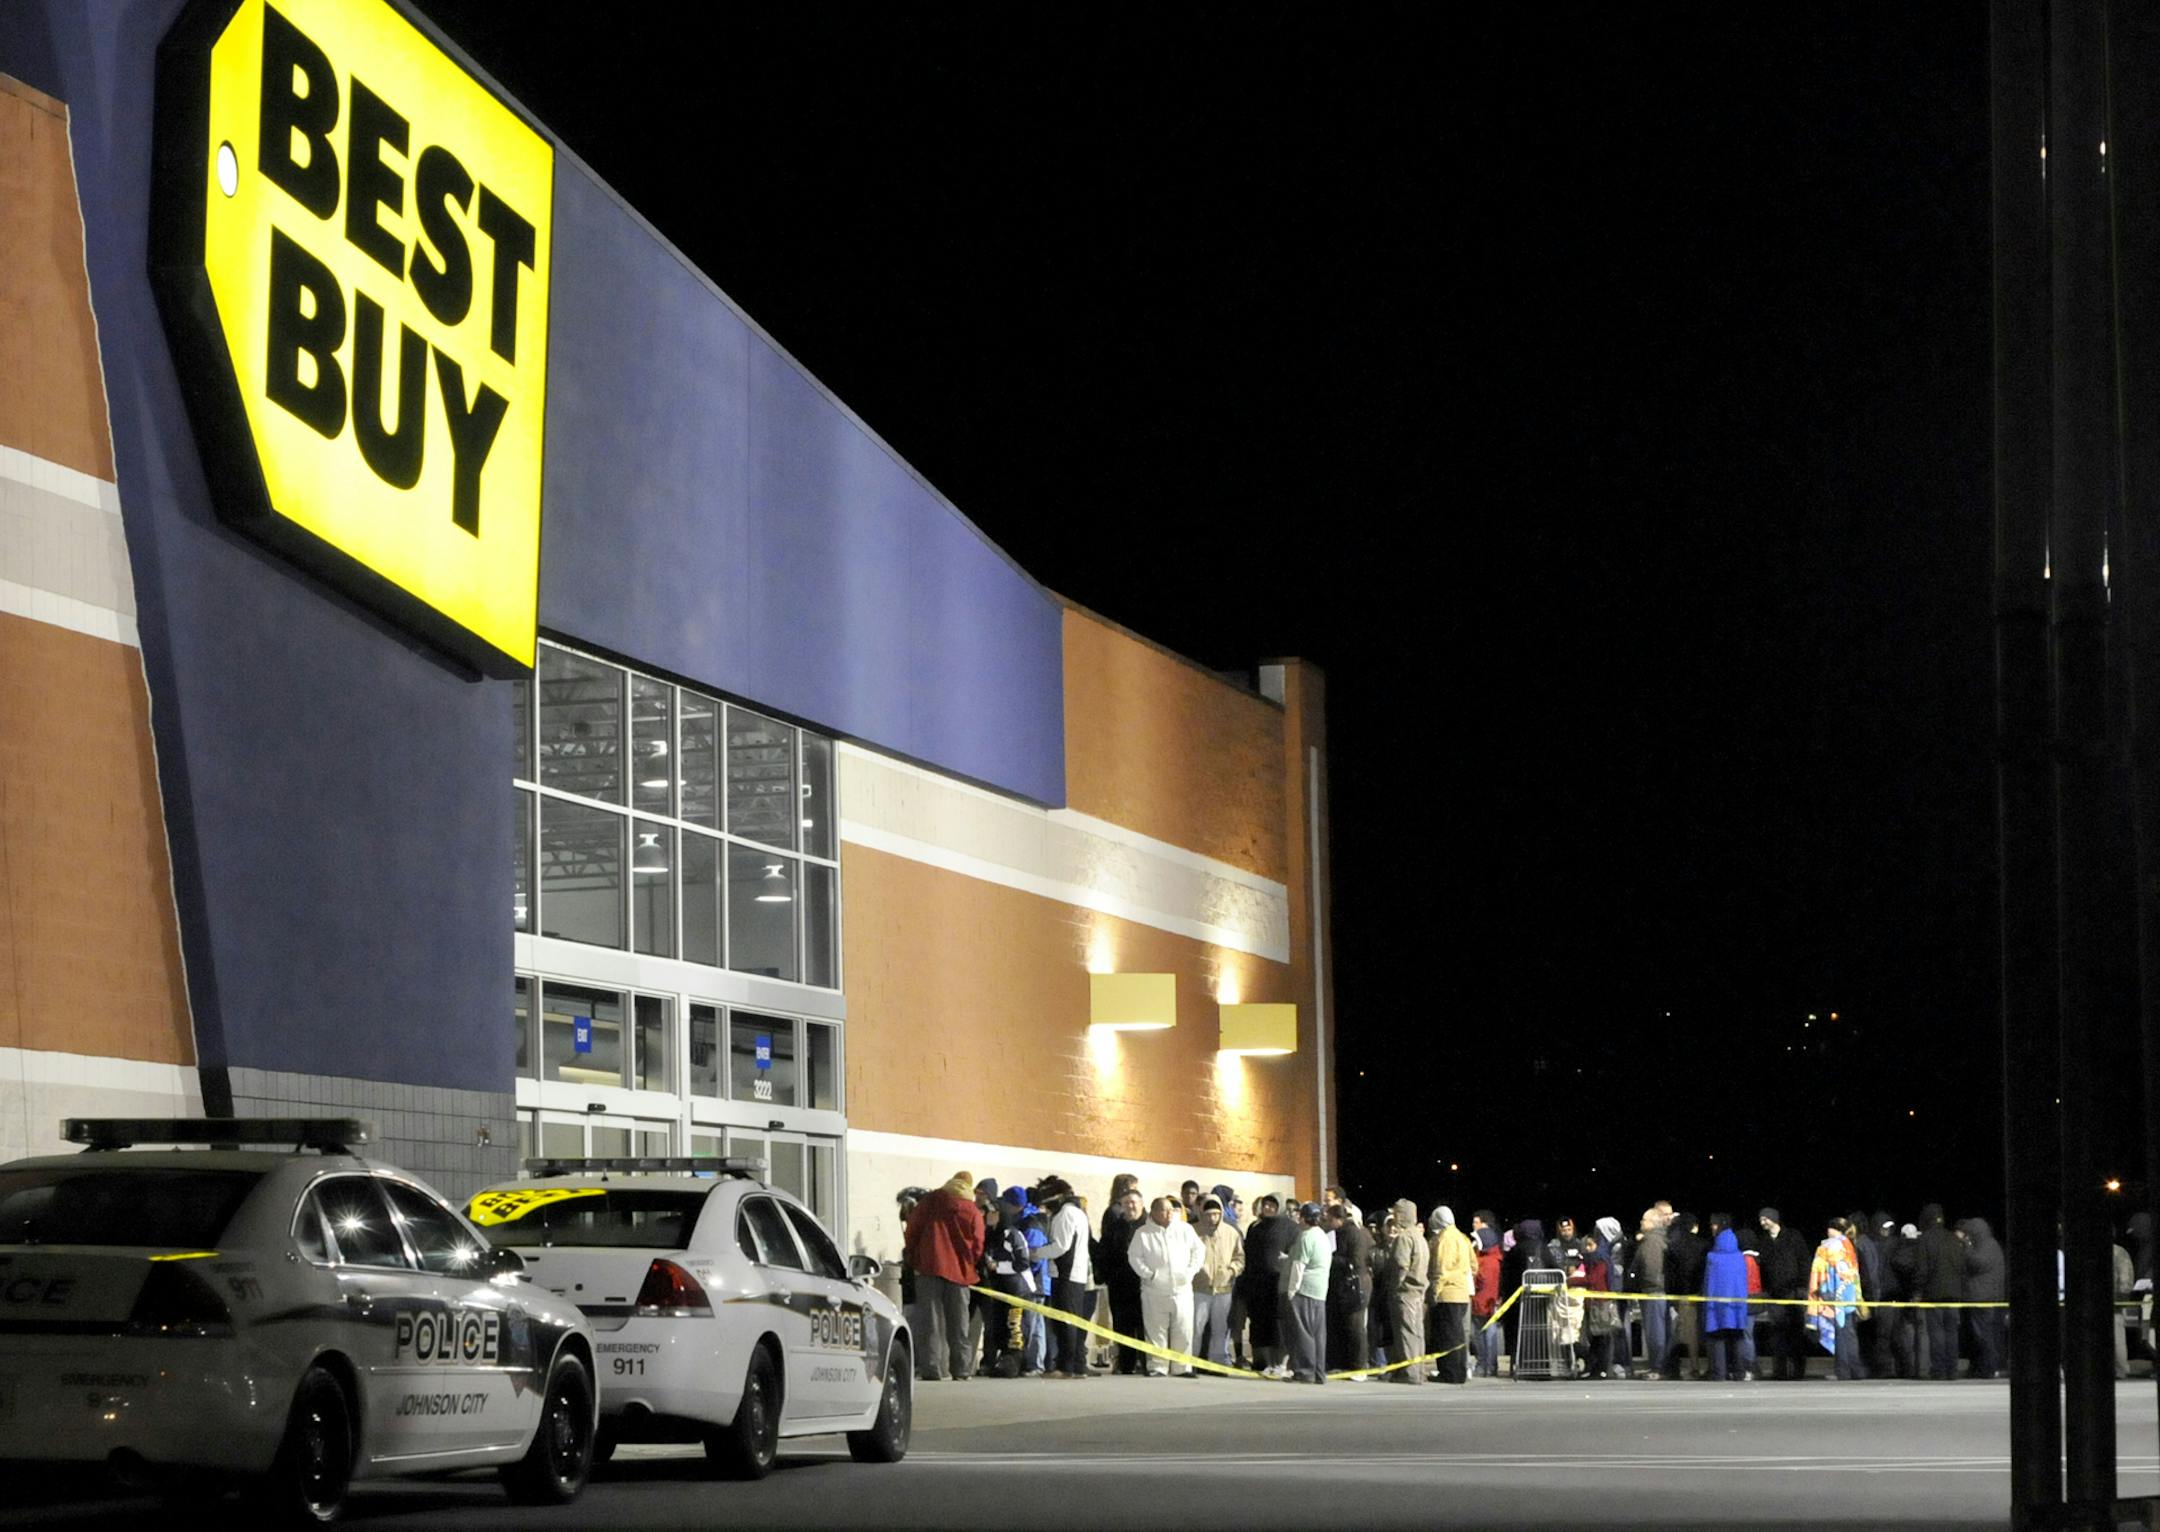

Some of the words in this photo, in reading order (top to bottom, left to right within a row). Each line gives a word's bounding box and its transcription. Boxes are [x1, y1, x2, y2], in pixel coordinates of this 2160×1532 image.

[258, 0, 536, 367] BEST
[266, 223, 510, 539] BUY
[577, 1028, 588, 1042] EXIT
[753, 1079, 772, 1100] 3222
[0, 1276, 75, 1304] CE
[394, 1311, 499, 1363] POLICE
[809, 1310, 861, 1349] POLICE
[596, 1343, 660, 1354] EMERGENCY
[613, 1357, 645, 1375] 911
[810, 1365, 842, 1382] JOHNSON
[843, 1367, 858, 1382] CITY
[395, 1392, 461, 1416] JOHNSON
[461, 1392, 488, 1415] CITY
